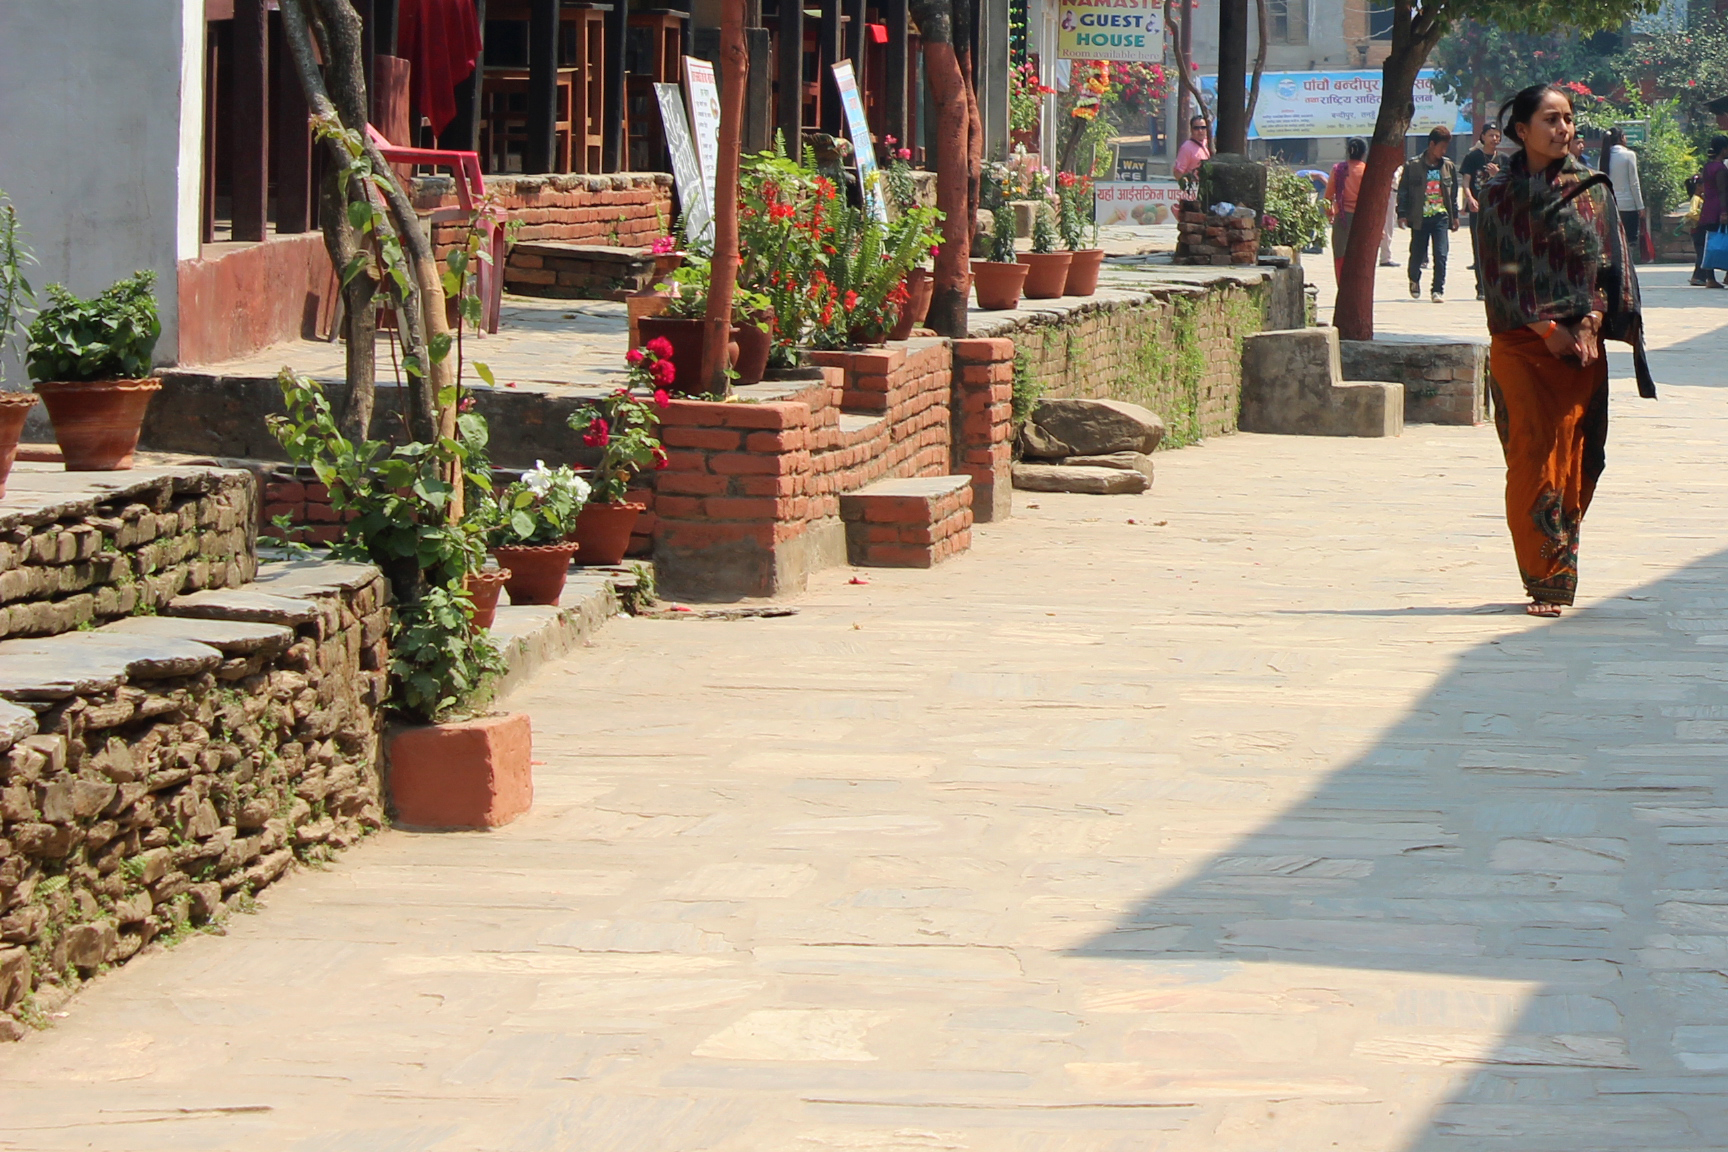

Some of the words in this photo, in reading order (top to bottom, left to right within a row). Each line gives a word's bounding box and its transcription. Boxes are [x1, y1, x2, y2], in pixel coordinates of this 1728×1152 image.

[1080, 13, 1143, 28] GUEST
[1076, 32, 1145, 47] HOUSE
[1062, 49, 1091, 58] Room
[1093, 49, 1136, 59] available
[1138, 50, 1160, 60] here
[1116, 171, 1142, 181] AFE
